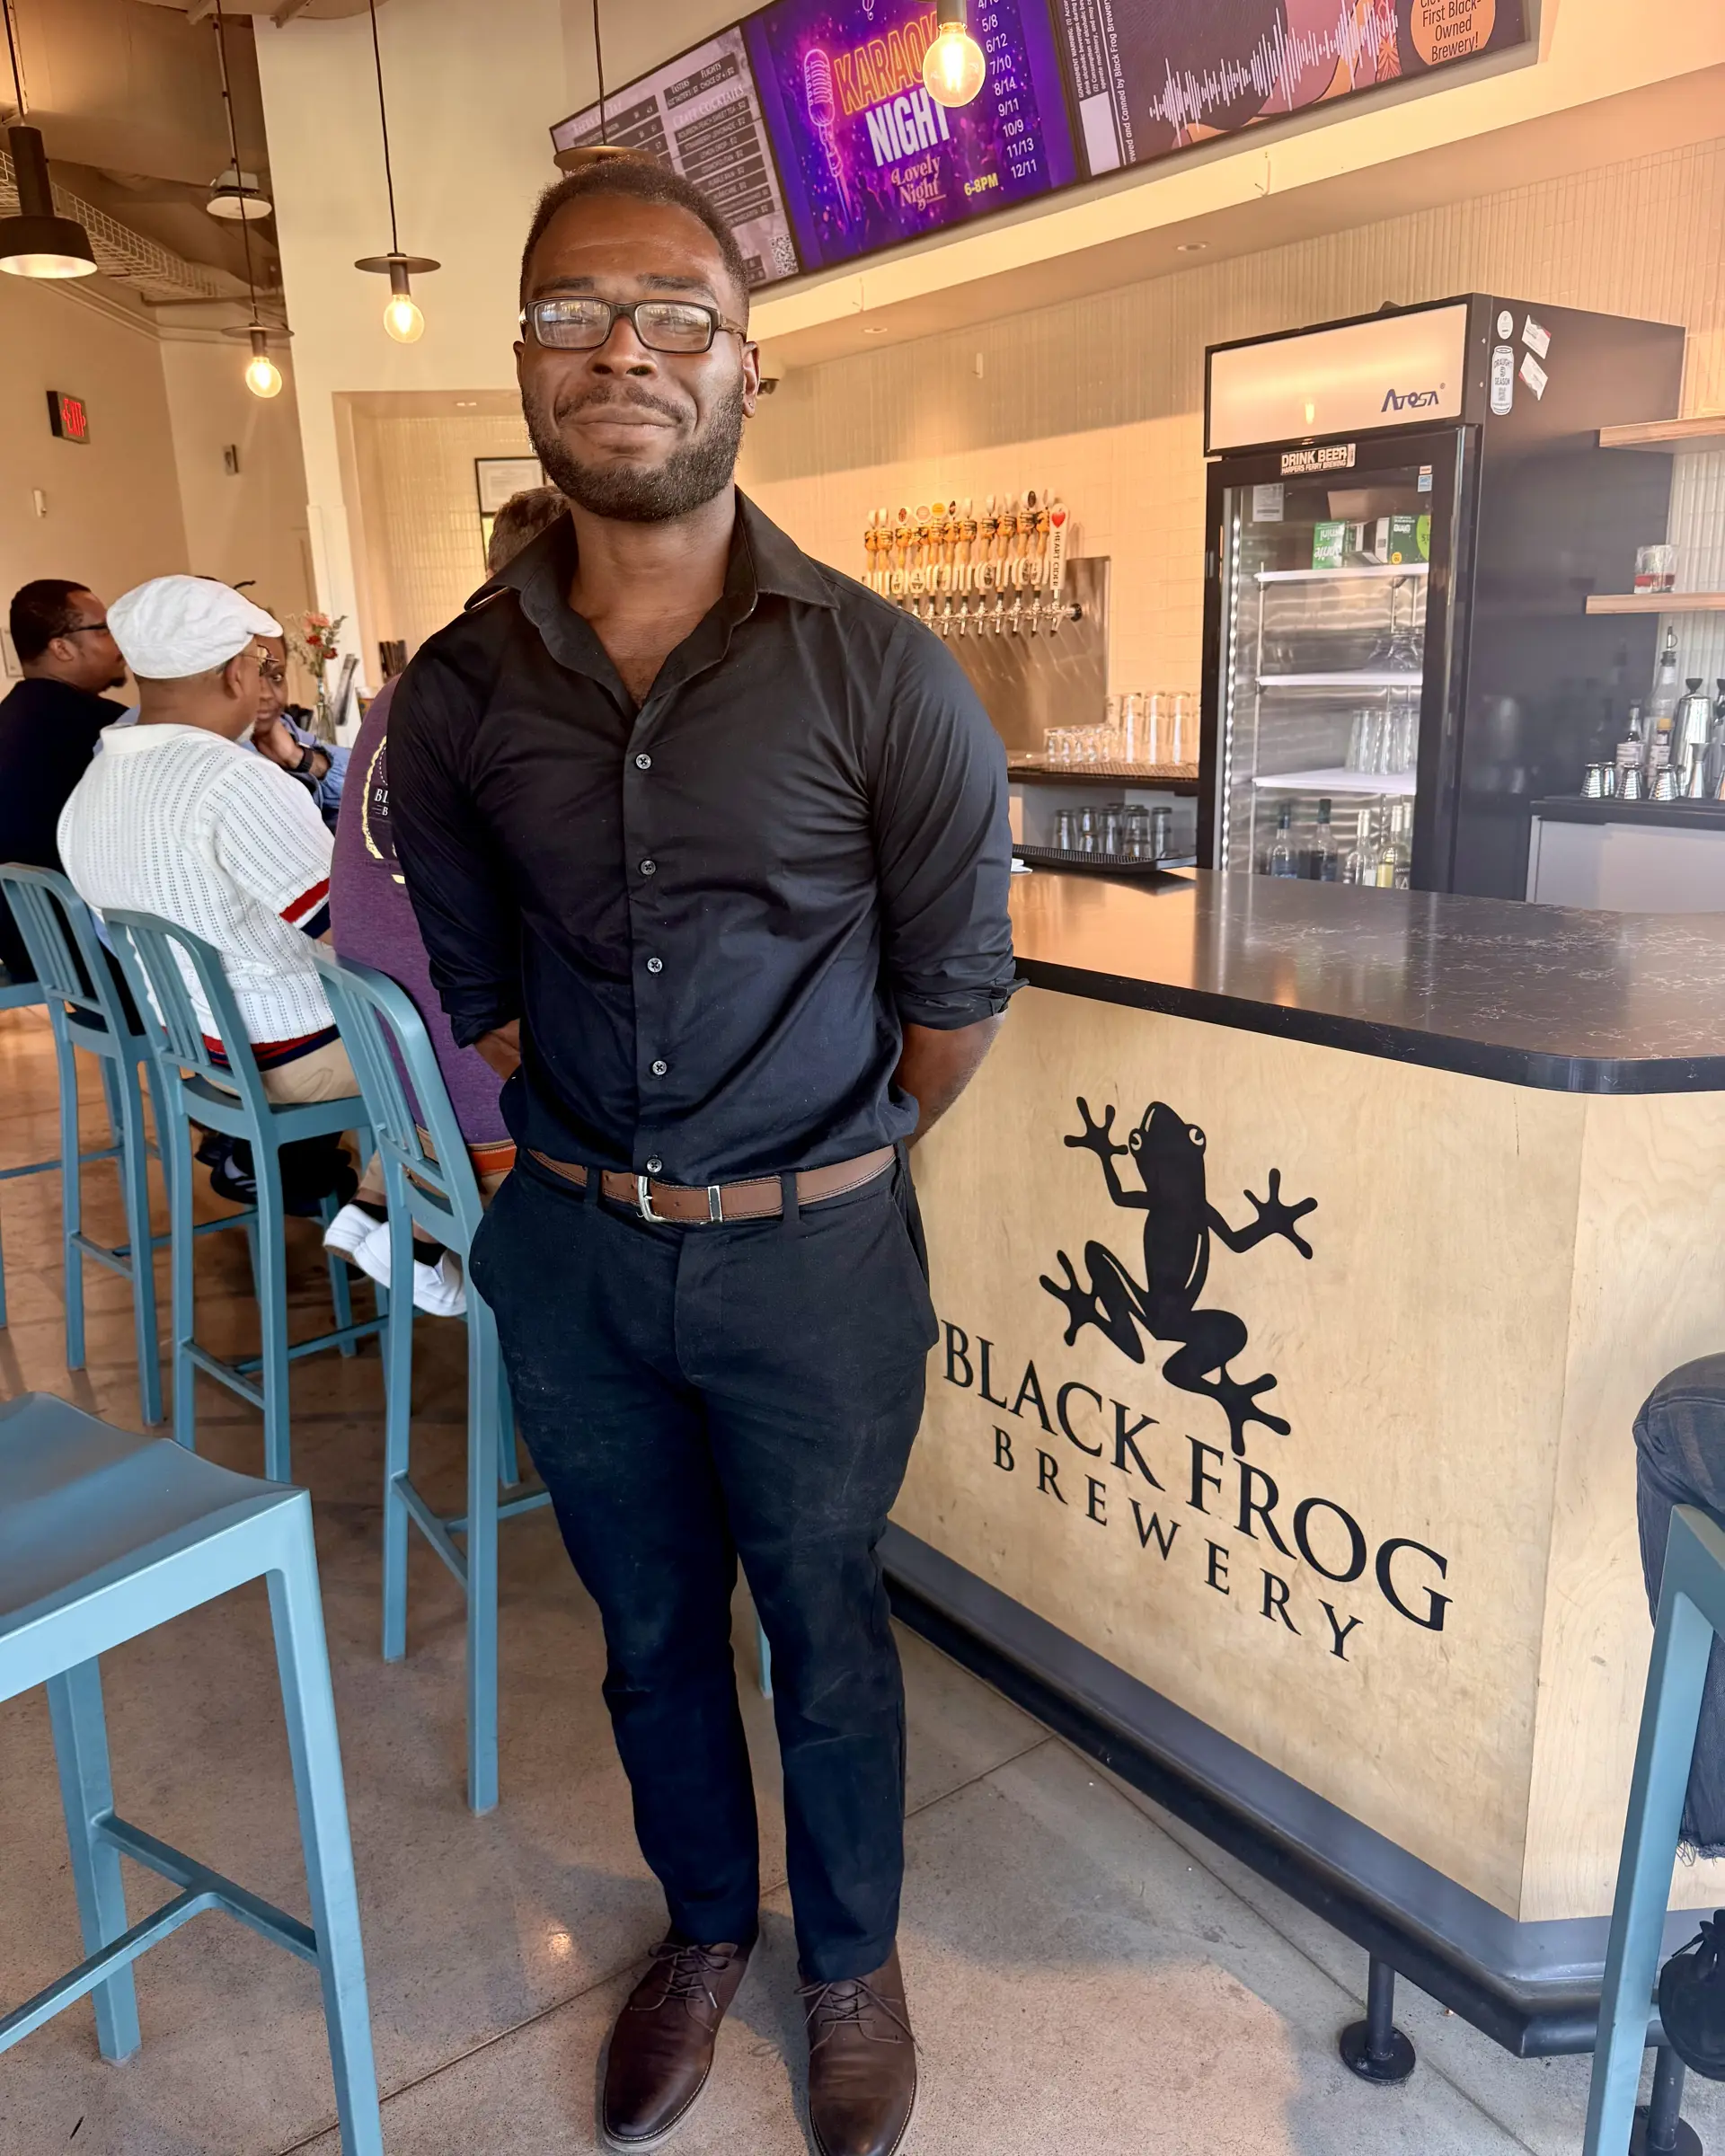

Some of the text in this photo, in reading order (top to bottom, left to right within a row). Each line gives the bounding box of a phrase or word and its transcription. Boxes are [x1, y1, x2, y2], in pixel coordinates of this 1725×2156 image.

[982, 14, 998, 32] 5/8
[1080, 10, 1090, 38] alcoholic
[1104, 0, 1114, 32] Brewer
[1422, 5, 1445, 27] First
[1448, 0, 1482, 18] Black-
[1435, 14, 1472, 41] Owned
[986, 33, 1008, 53] 6/12
[1071, 2, 1092, 95] drink alcoholic beverages during
[1110, 33, 1118, 53] Frog
[1431, 31, 1479, 62] Brewery!
[701, 62, 721, 78] FLIGHTS
[834, 11, 937, 116] KARAOK
[989, 54, 1012, 75] 7/10
[1086, 45, 1097, 83] Consumption
[1111, 54, 1122, 77] Black
[994, 78, 1017, 96] 8/14
[1072, 58, 1084, 98] GOVERNMENT
[1092, 84, 1100, 93] (2)
[1098, 66, 1107, 90] operate
[1116, 78, 1125, 89] by
[699, 85, 743, 115] COCKTAILS
[997, 97, 1020, 117] 9/11
[1118, 90, 1129, 121] Canned
[1002, 120, 1024, 137] 10/9
[1122, 122, 1132, 138] and
[1006, 137, 1034, 159] 11/13
[891, 155, 942, 184] Lovely
[1010, 159, 1038, 180] 12/11
[900, 179, 941, 211] Night
[964, 172, 999, 197] 6-8PM
[64, 398, 84, 437] EXIT
[1282, 446, 1348, 467] DRINK BEER
[1282, 460, 1347, 474] HARPERS FERRY BREWING
[941, 1319, 1453, 1632] BLACK FROG
[991, 1425, 1364, 1662] BREWERY
